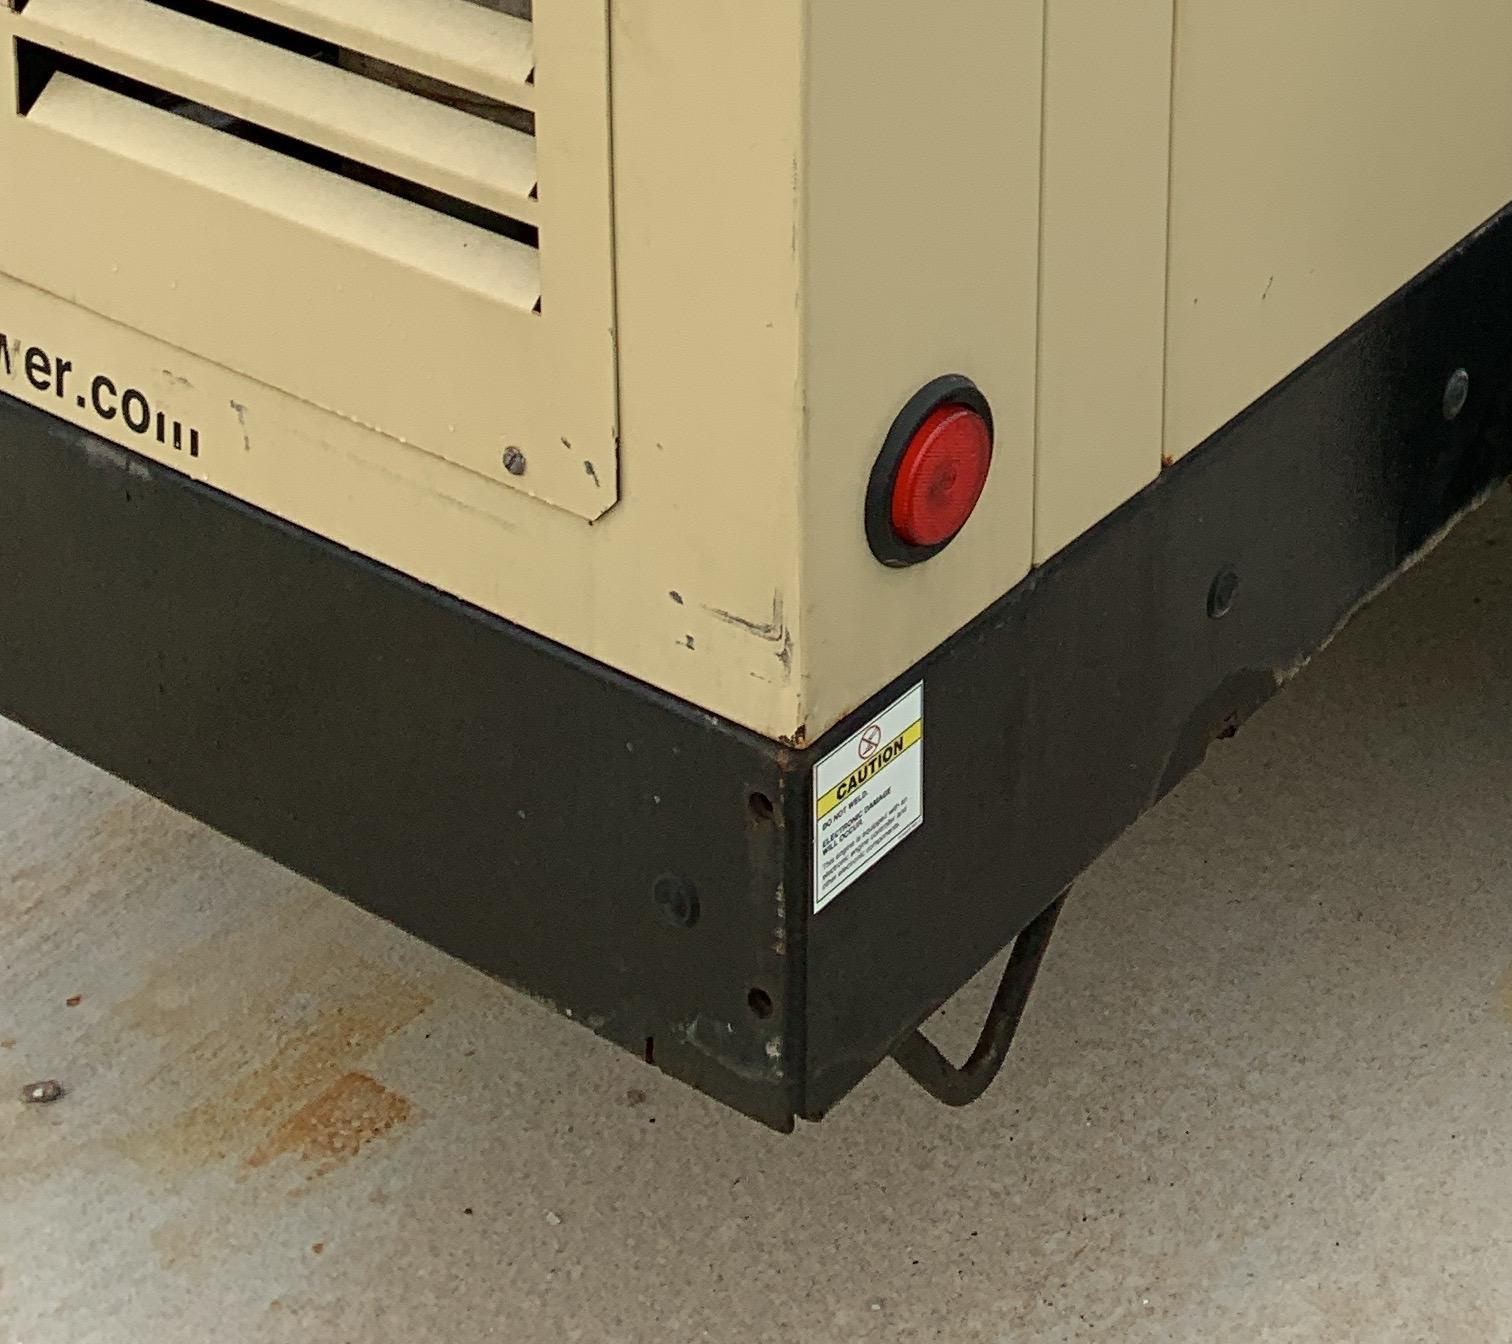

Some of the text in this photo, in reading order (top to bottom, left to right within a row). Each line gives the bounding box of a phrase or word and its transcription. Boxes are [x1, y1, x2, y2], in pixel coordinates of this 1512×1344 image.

[836, 736, 904, 801] CAUTION
[822, 817, 832, 831] DO
[833, 805, 847, 823] NOT
